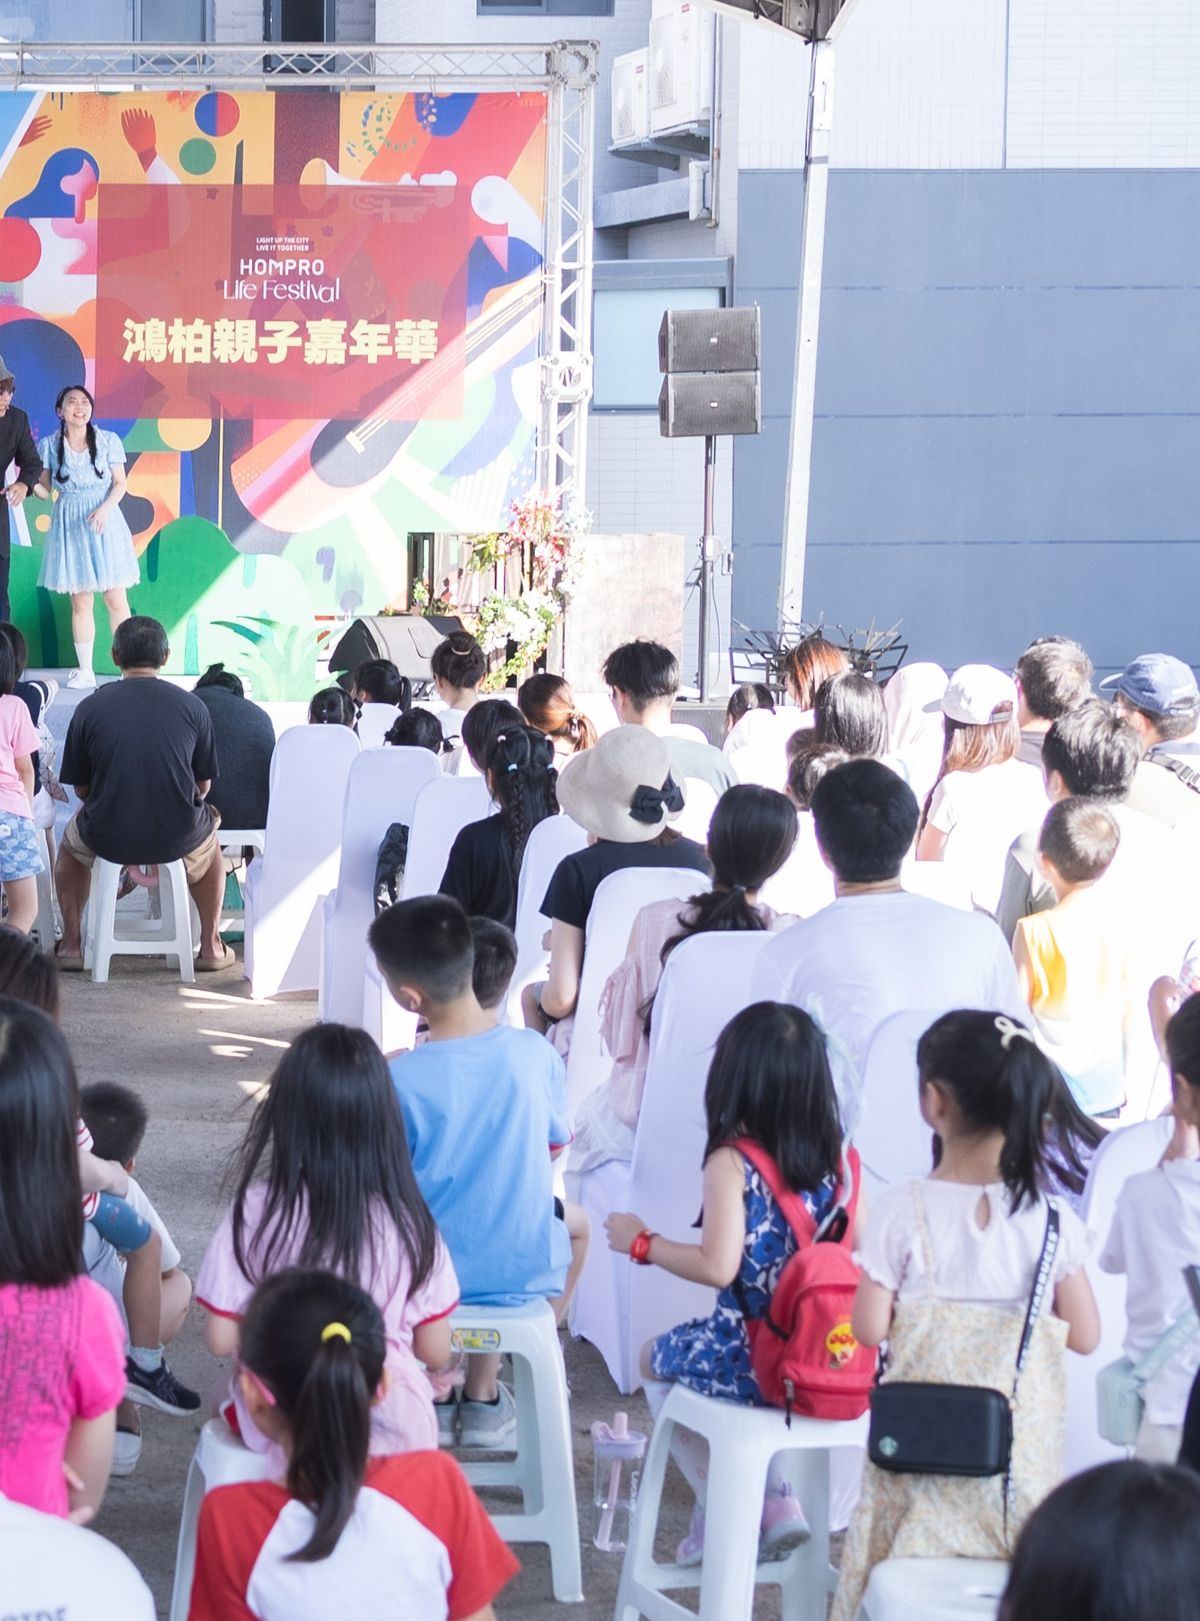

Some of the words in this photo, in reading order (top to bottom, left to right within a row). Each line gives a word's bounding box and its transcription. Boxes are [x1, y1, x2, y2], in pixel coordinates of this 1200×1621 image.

[240, 259, 324, 276] HOMPRO
[223, 279, 257, 300] Life
[263, 277, 340, 303] Festival
[122, 318, 439, 365] 鴻柏親子嘉年華
[1028, 1231, 1058, 1325] STARBUCKS
